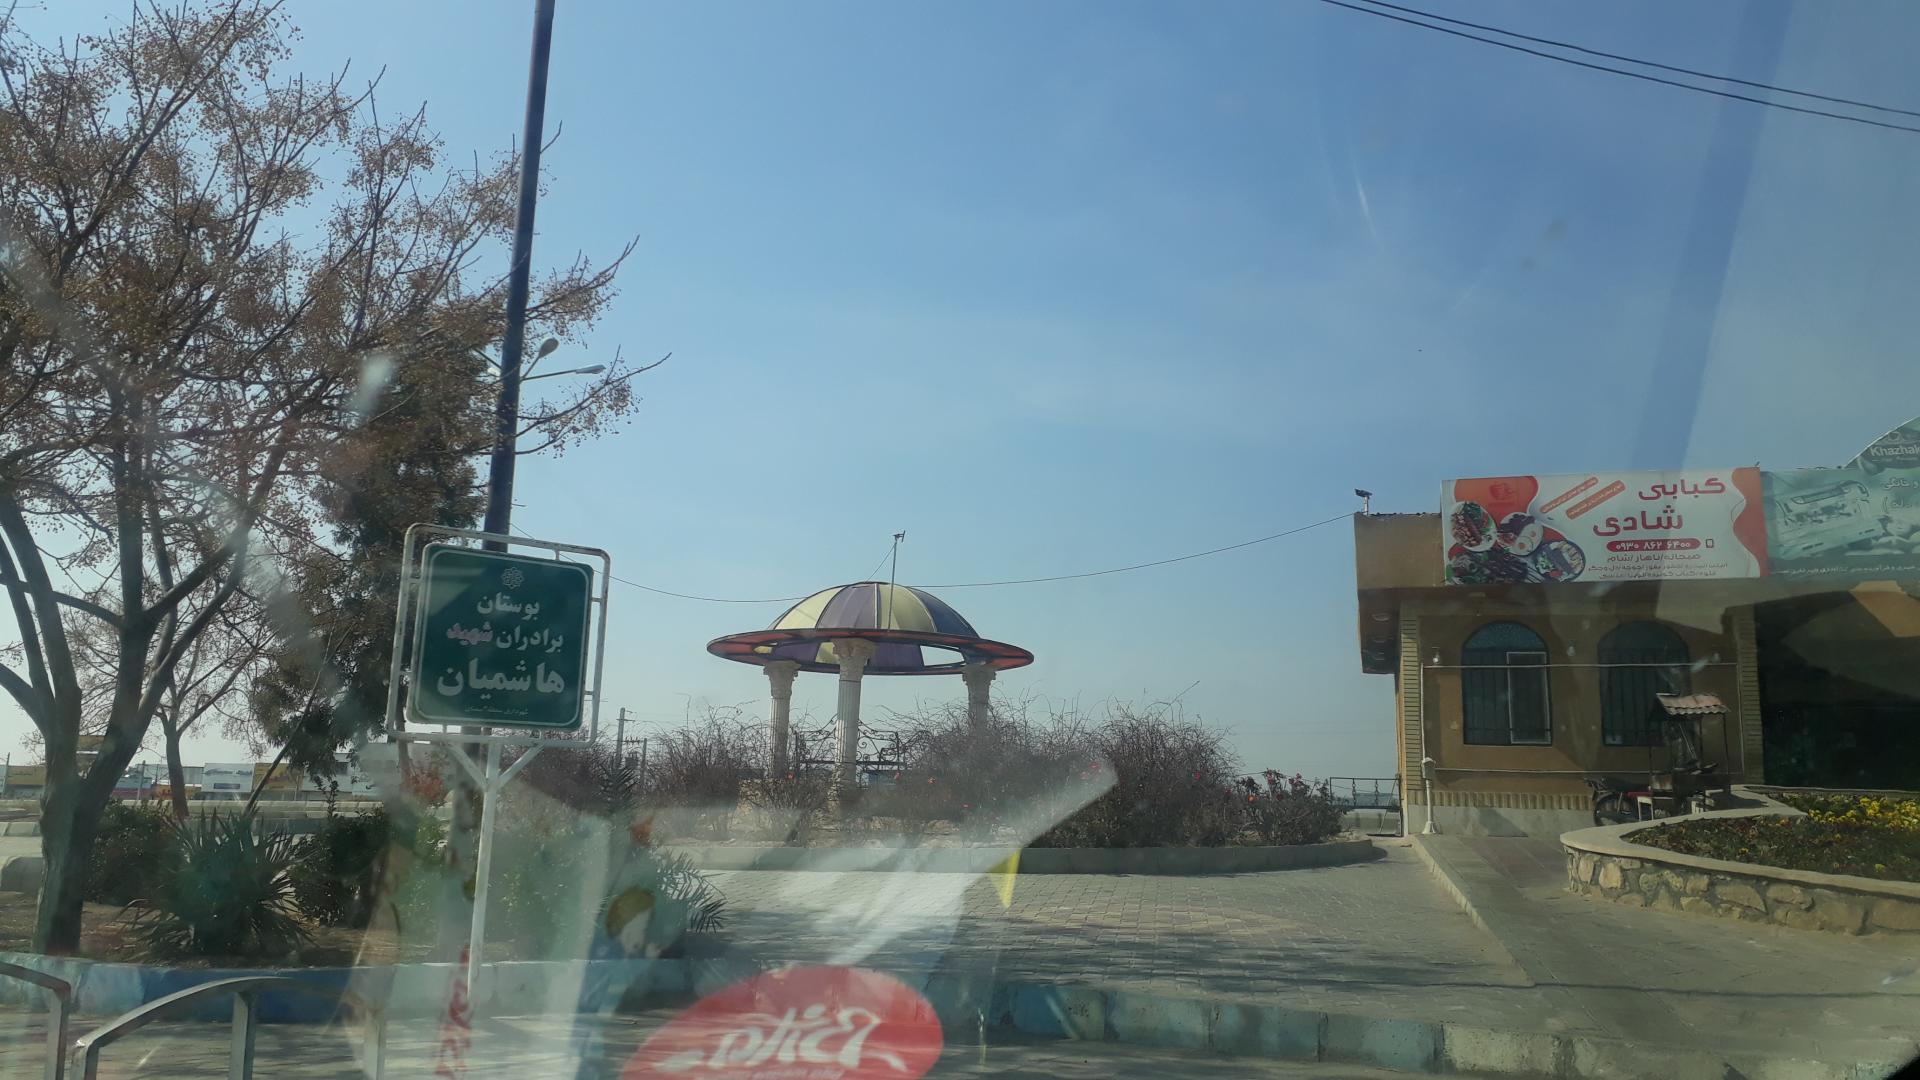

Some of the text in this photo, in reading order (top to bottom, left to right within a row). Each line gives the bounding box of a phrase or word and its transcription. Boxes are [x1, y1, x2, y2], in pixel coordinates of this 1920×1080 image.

[1638, 478, 1726, 500] کبابی
[1593, 504, 1684, 537] شادی
[476, 592, 540, 620] بوستان
[446, 621, 564, 653] برادران شهید
[436, 658, 565, 700] هاشمیان
